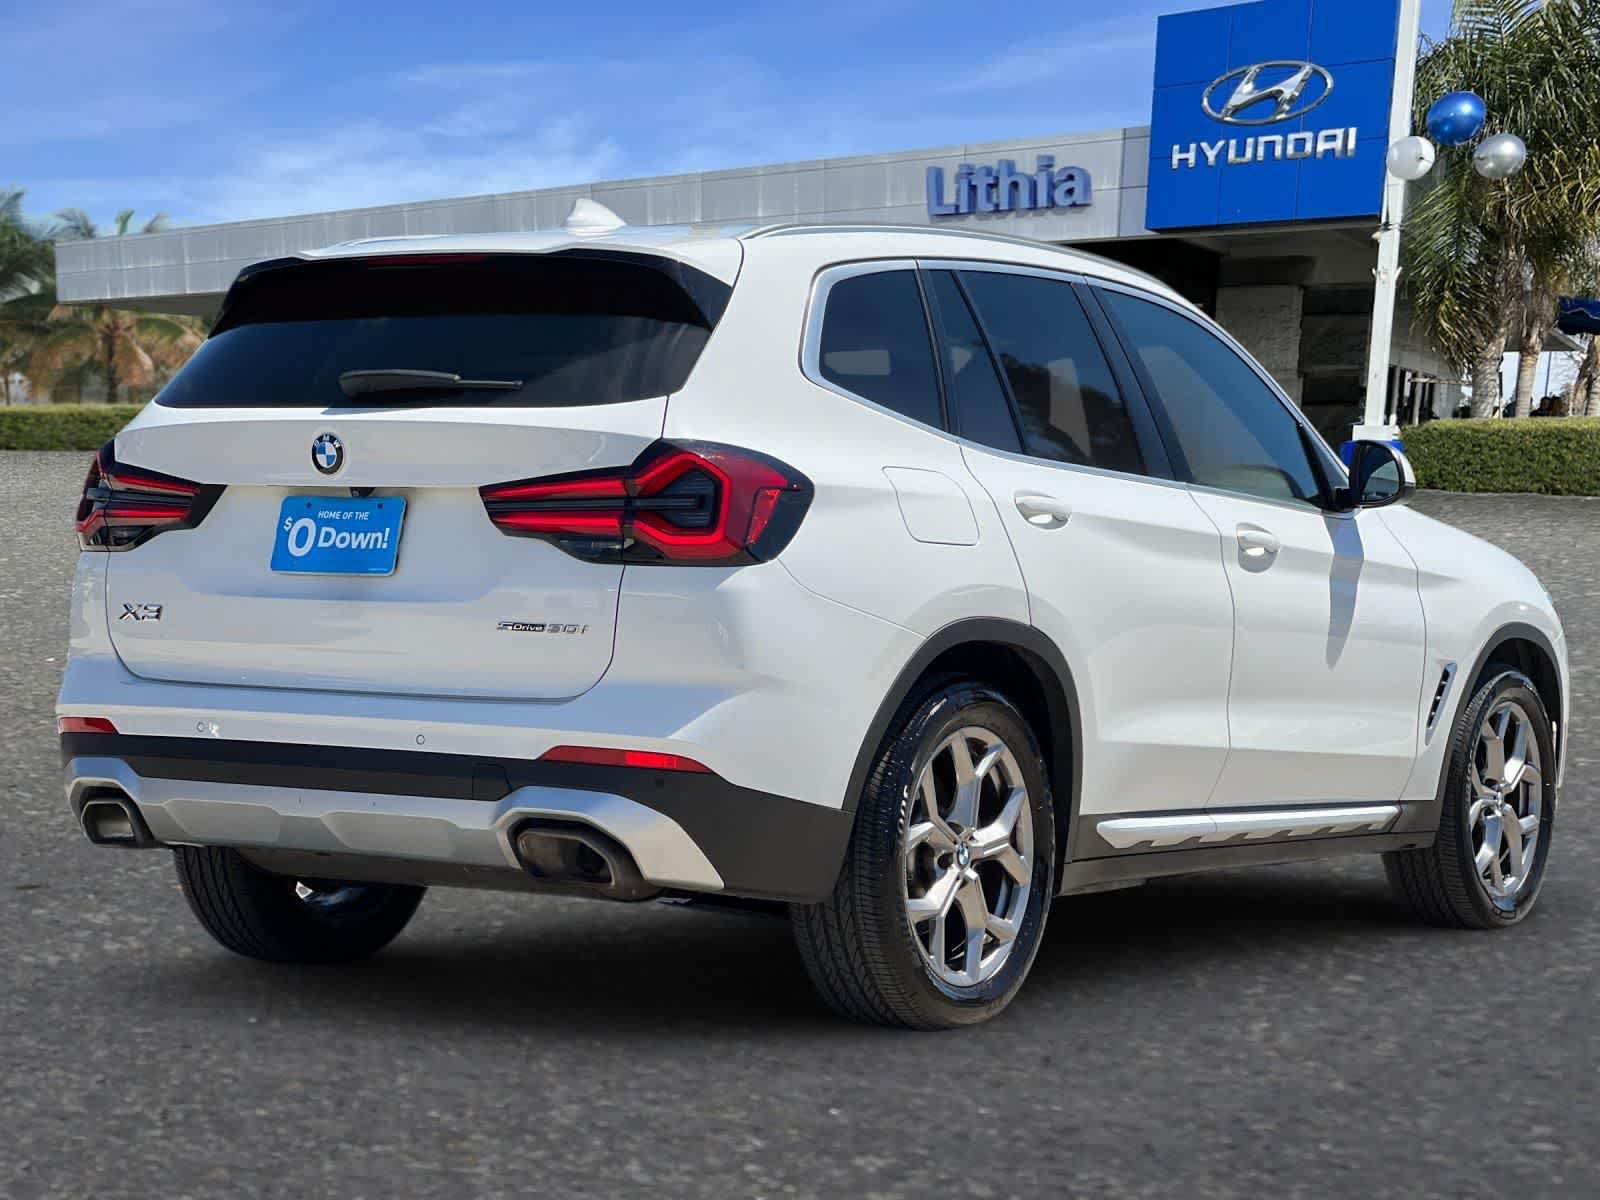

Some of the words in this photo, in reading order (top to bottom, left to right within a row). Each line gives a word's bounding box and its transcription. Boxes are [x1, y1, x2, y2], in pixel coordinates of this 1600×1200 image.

[1171, 126, 1357, 169] HYUNDAI
[926, 155, 1092, 217] Lithia
[318, 510, 341, 519] HOME
[342, 511, 353, 520] OF
[355, 512, 370, 520] THE
[317, 527, 390, 549] Down!
[119, 603, 162, 621] X3
